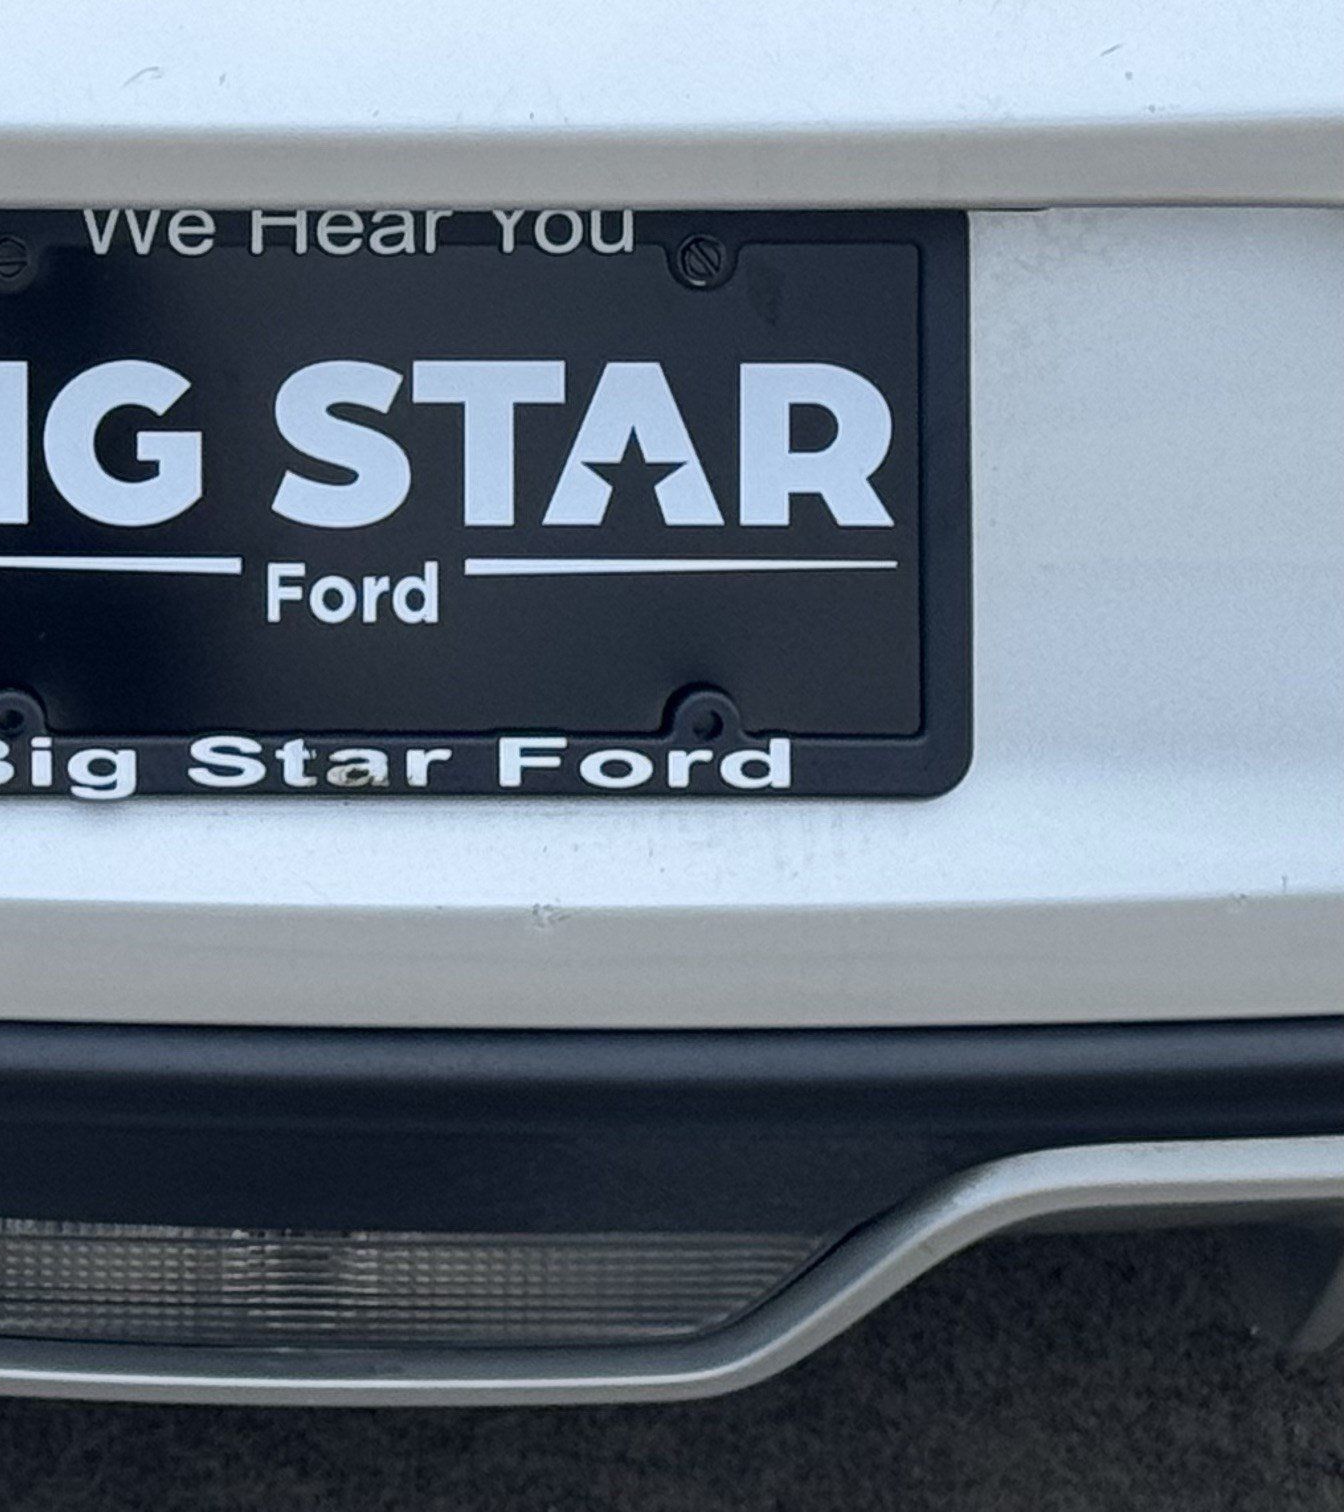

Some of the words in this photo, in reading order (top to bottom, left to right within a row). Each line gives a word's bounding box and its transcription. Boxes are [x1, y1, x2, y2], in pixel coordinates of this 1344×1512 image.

[83, 208, 216, 255] We
[250, 208, 453, 255] Hear
[491, 208, 635, 255] You
[271, 359, 896, 529] STAR
[265, 562, 440, 624] Ford
[187, 736, 452, 789] Star
[497, 736, 793, 790] Ford
